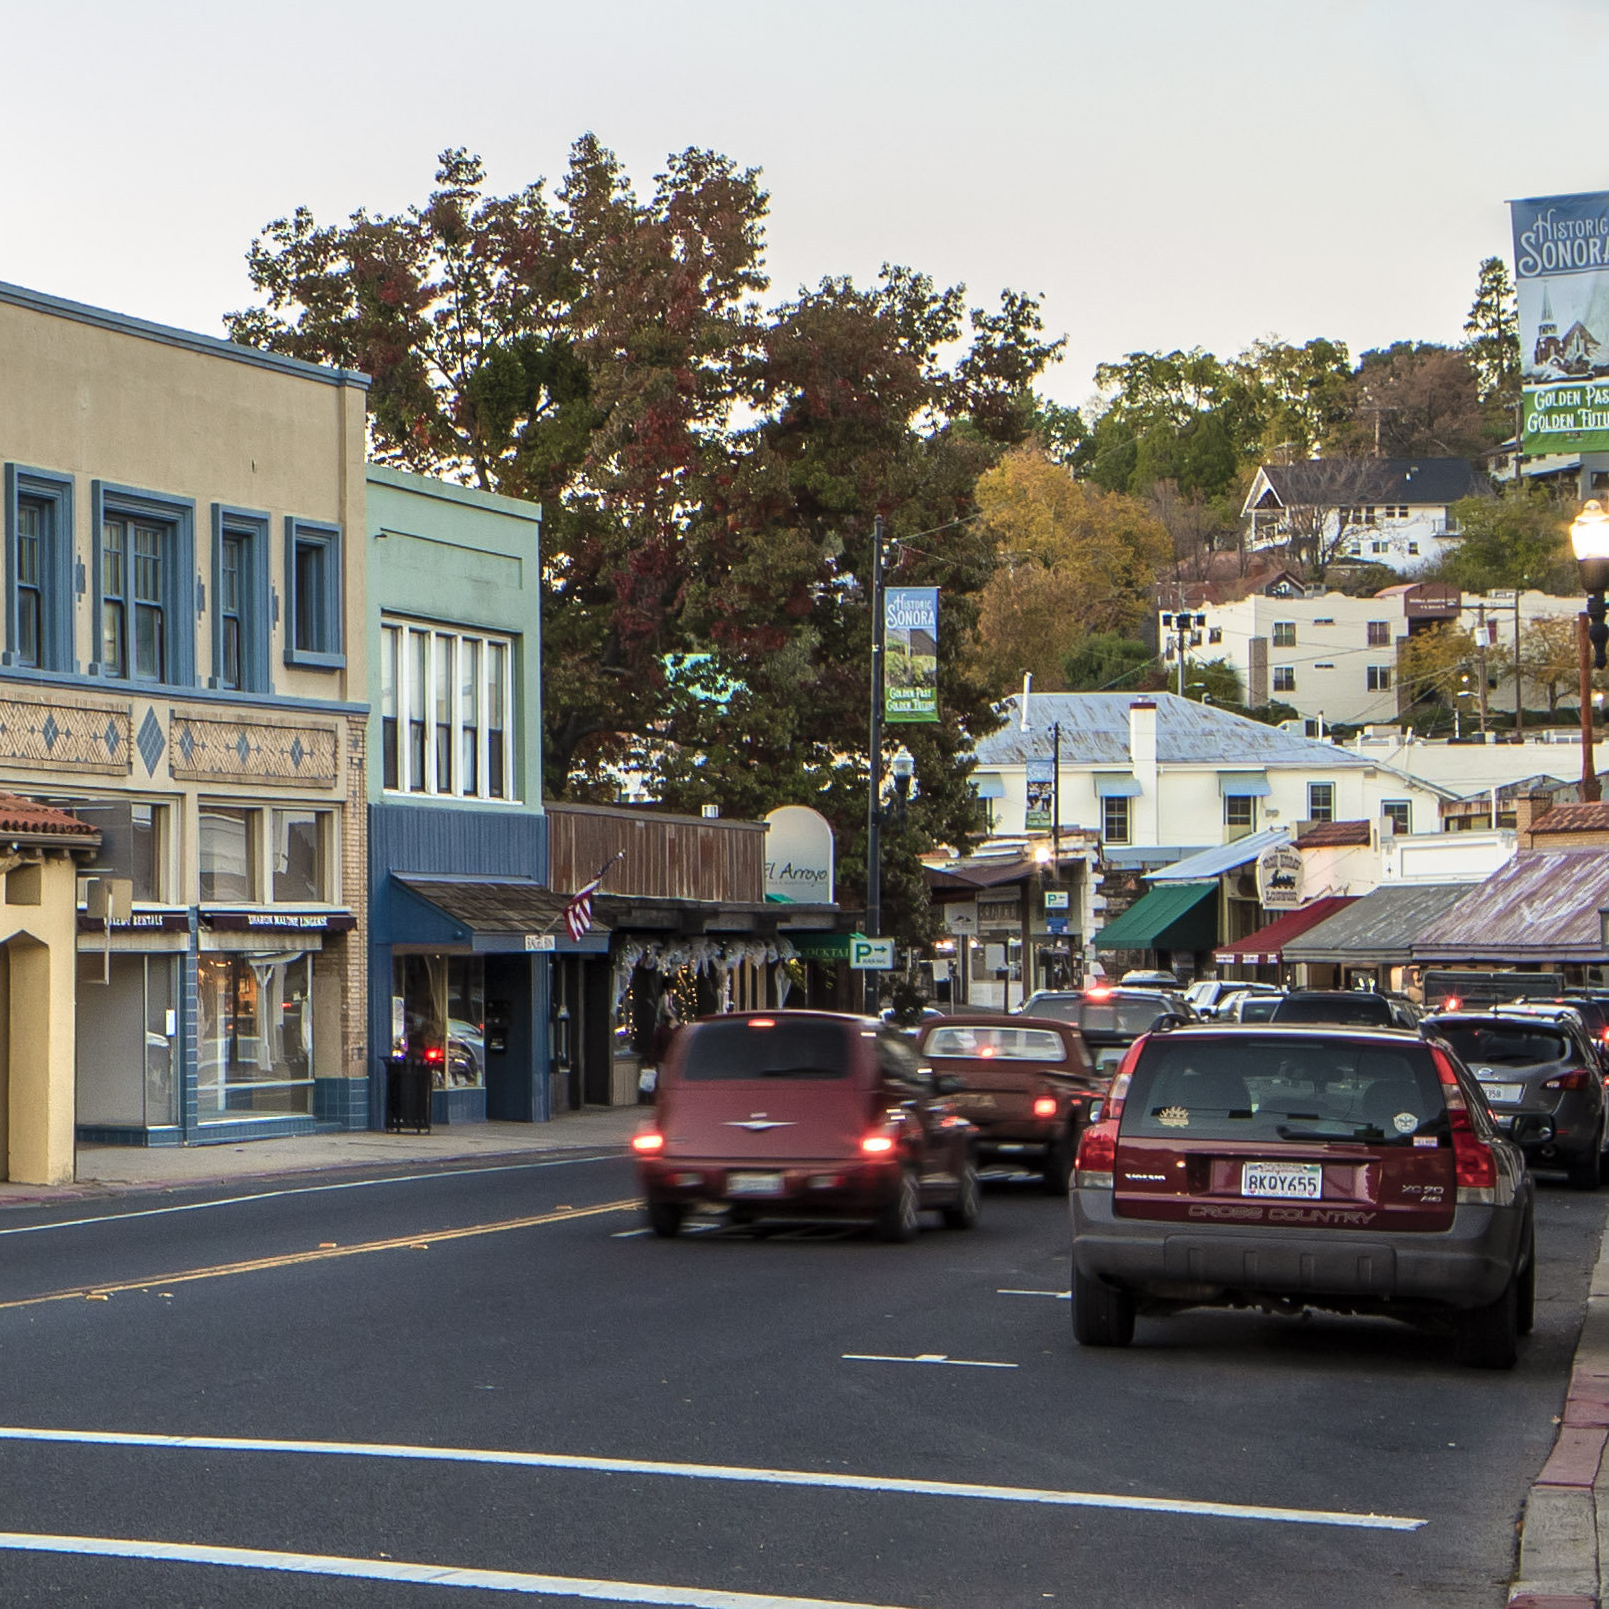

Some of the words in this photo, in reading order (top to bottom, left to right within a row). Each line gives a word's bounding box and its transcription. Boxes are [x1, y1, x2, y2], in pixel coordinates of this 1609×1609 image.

[1534, 390, 1581, 411] GOLDEN
[1527, 411, 1575, 433] GOLDEN
[885, 603, 935, 629] SONORA
[779, 862, 828, 888] Arroyo
[856, 942, 873, 964] P
[1188, 1204, 1263, 1220] CROSS
[1268, 1207, 1377, 1225] COUNTRY
